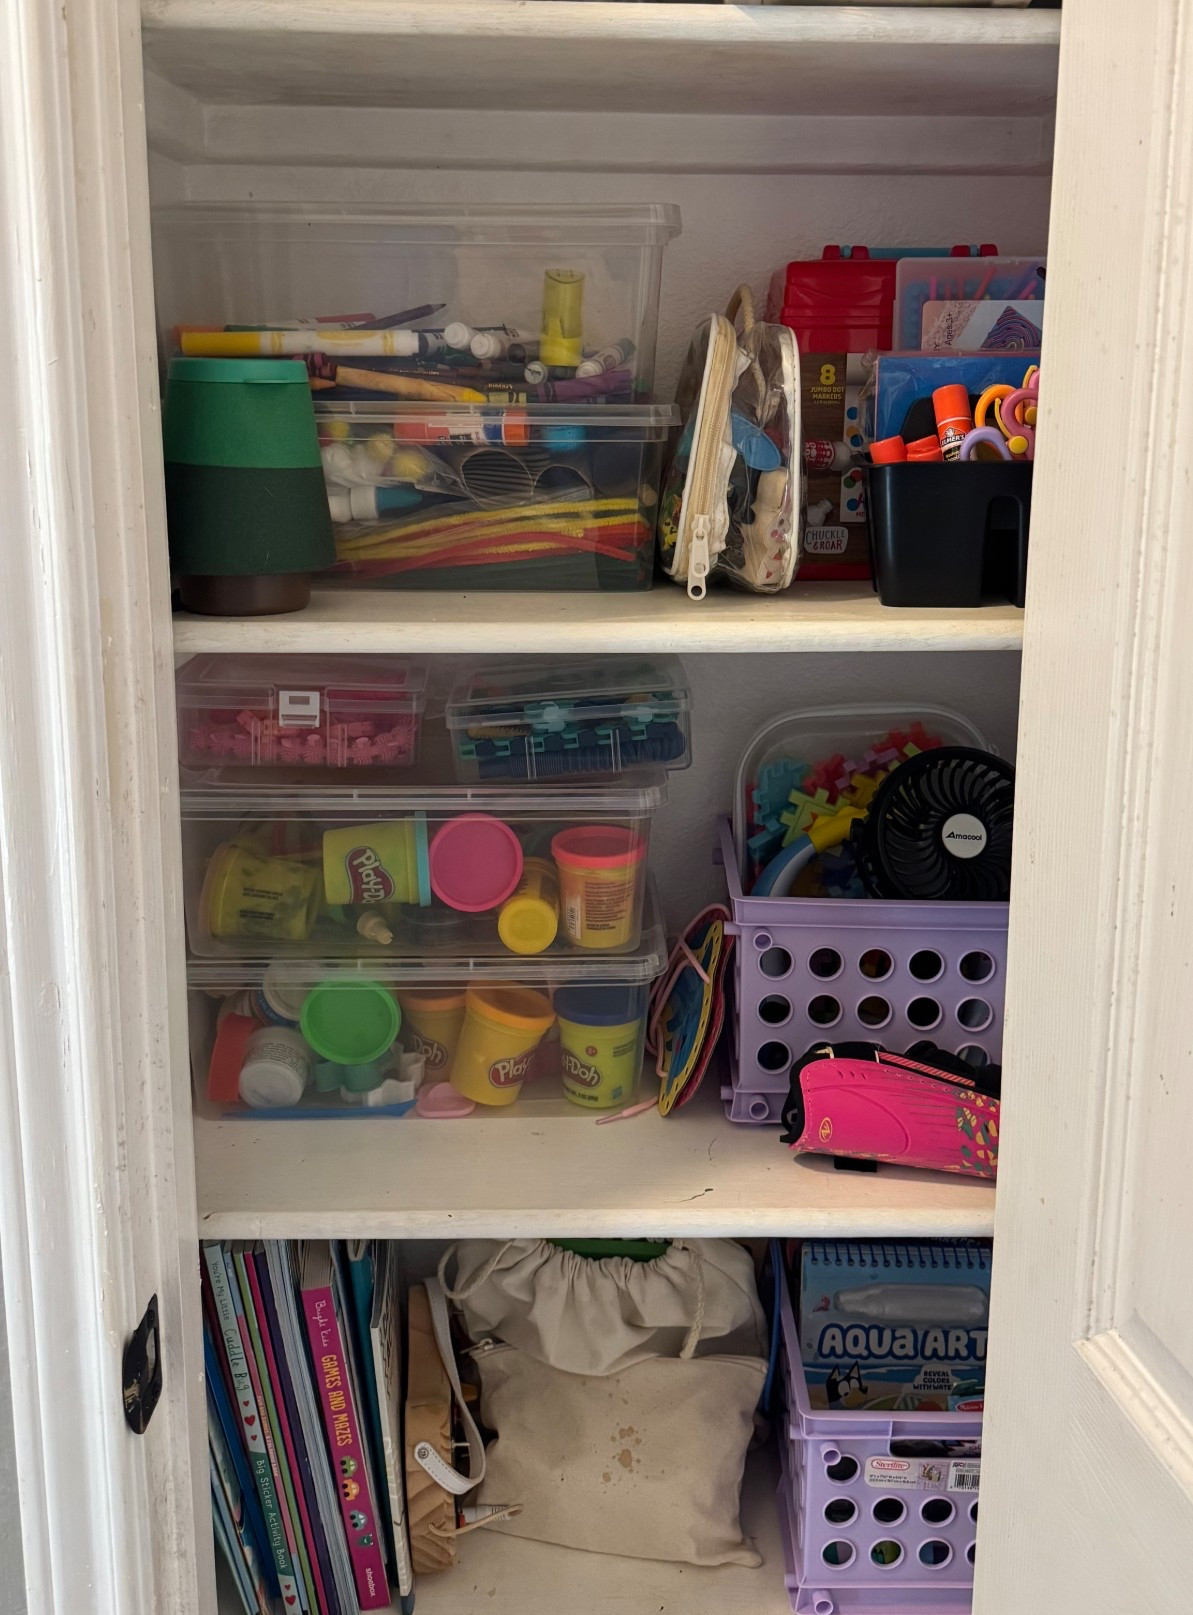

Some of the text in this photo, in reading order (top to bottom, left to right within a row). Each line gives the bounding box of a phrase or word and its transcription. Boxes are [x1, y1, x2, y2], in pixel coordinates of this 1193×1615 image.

[820, 364, 836, 385] 8
[805, 529, 846, 545] CHUCKLE
[945, 831, 983, 841] Amacool
[211, 1261, 221, 1284] You're
[216, 1286, 225, 1298] My
[220, 1298, 230, 1321] Little
[223, 1328, 244, 1368] Cuddle
[922, 1328, 988, 1358] ART
[321, 1354, 341, 1389] GAMES
[328, 1391, 346, 1412] AND
[332, 1413, 353, 1447] MAZES
[875, 1460, 906, 1469] Sterilite
[256, 1459, 287, 1569] Big Sticker Activity Book
[365, 1567, 376, 1597] shoebox
